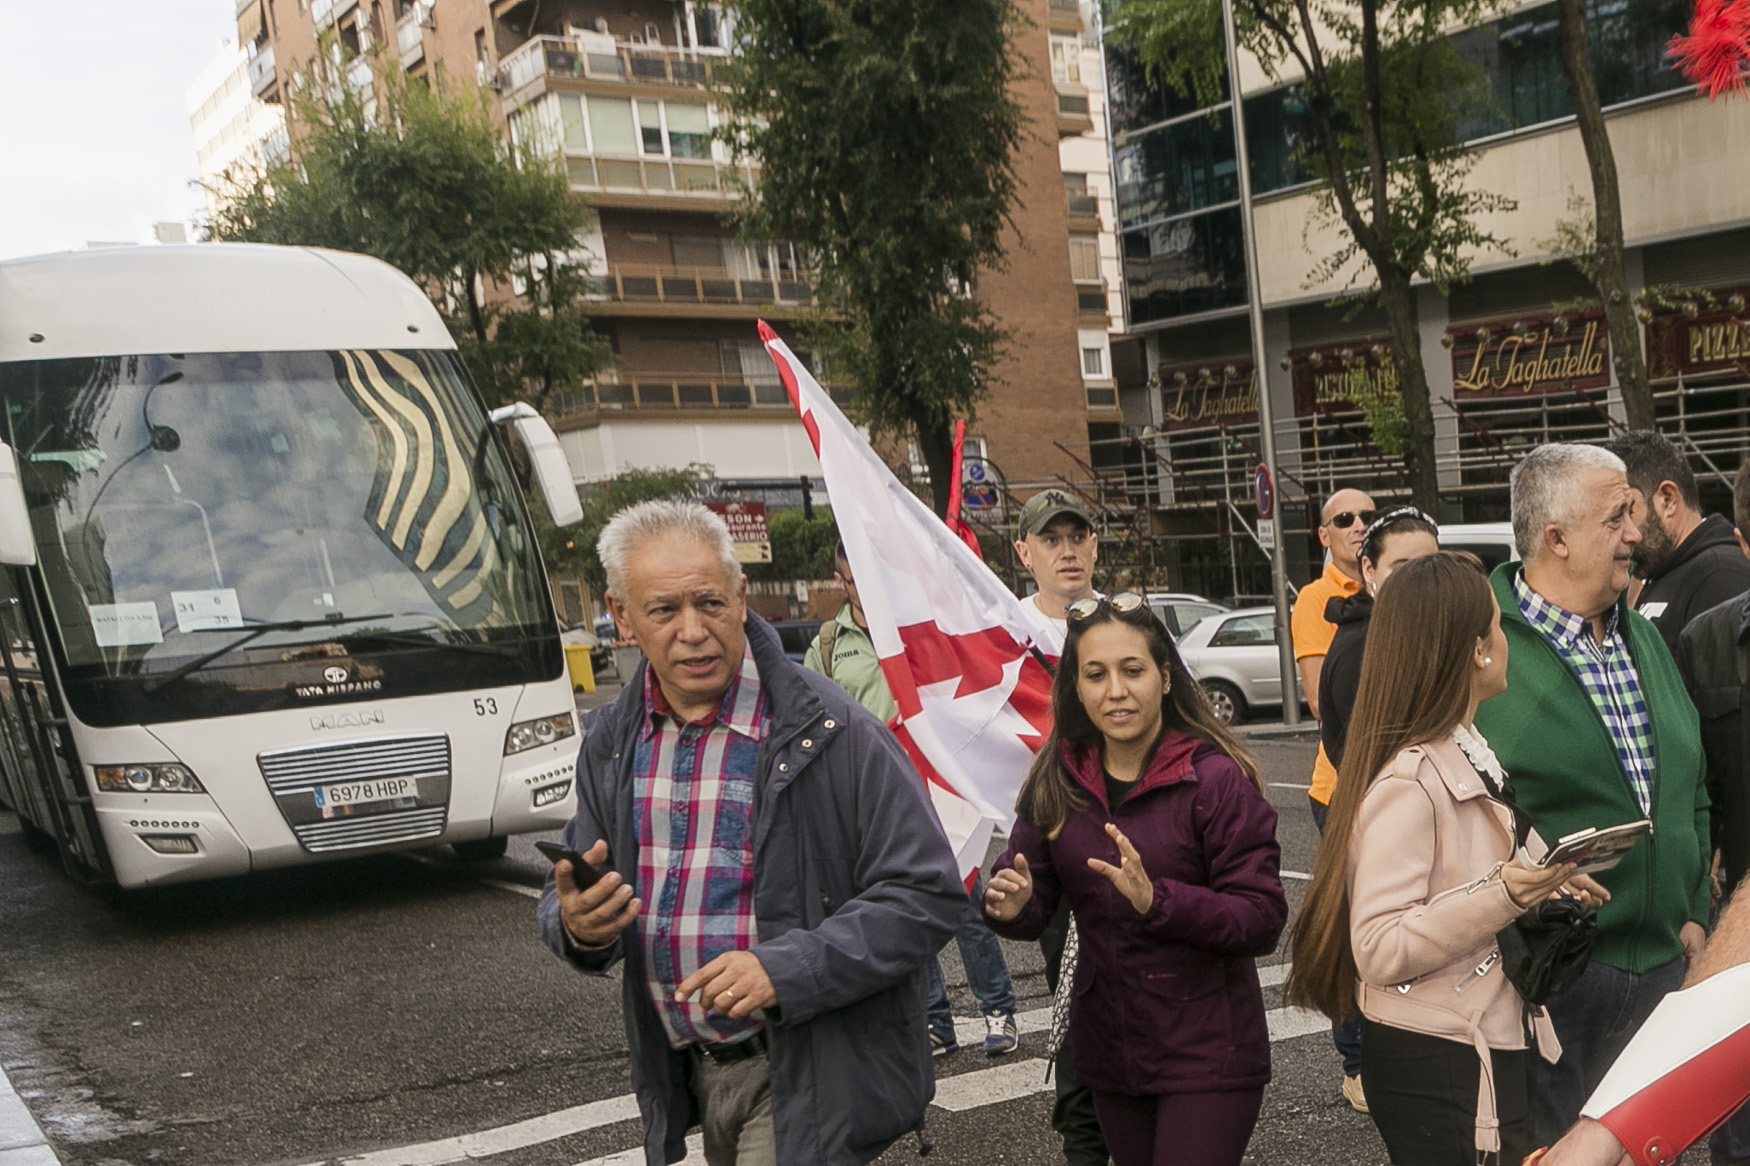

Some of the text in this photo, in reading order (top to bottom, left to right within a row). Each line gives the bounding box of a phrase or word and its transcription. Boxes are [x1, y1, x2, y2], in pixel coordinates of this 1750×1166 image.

[1453, 320, 1603, 393] La Tagliatella
[732, 531, 768, 541] ASERIO
[295, 680, 382, 697] TATA HISPANO
[473, 697, 498, 716] 53
[310, 709, 385, 731] MAN
[329, 779, 409, 803] 6978 HBP
